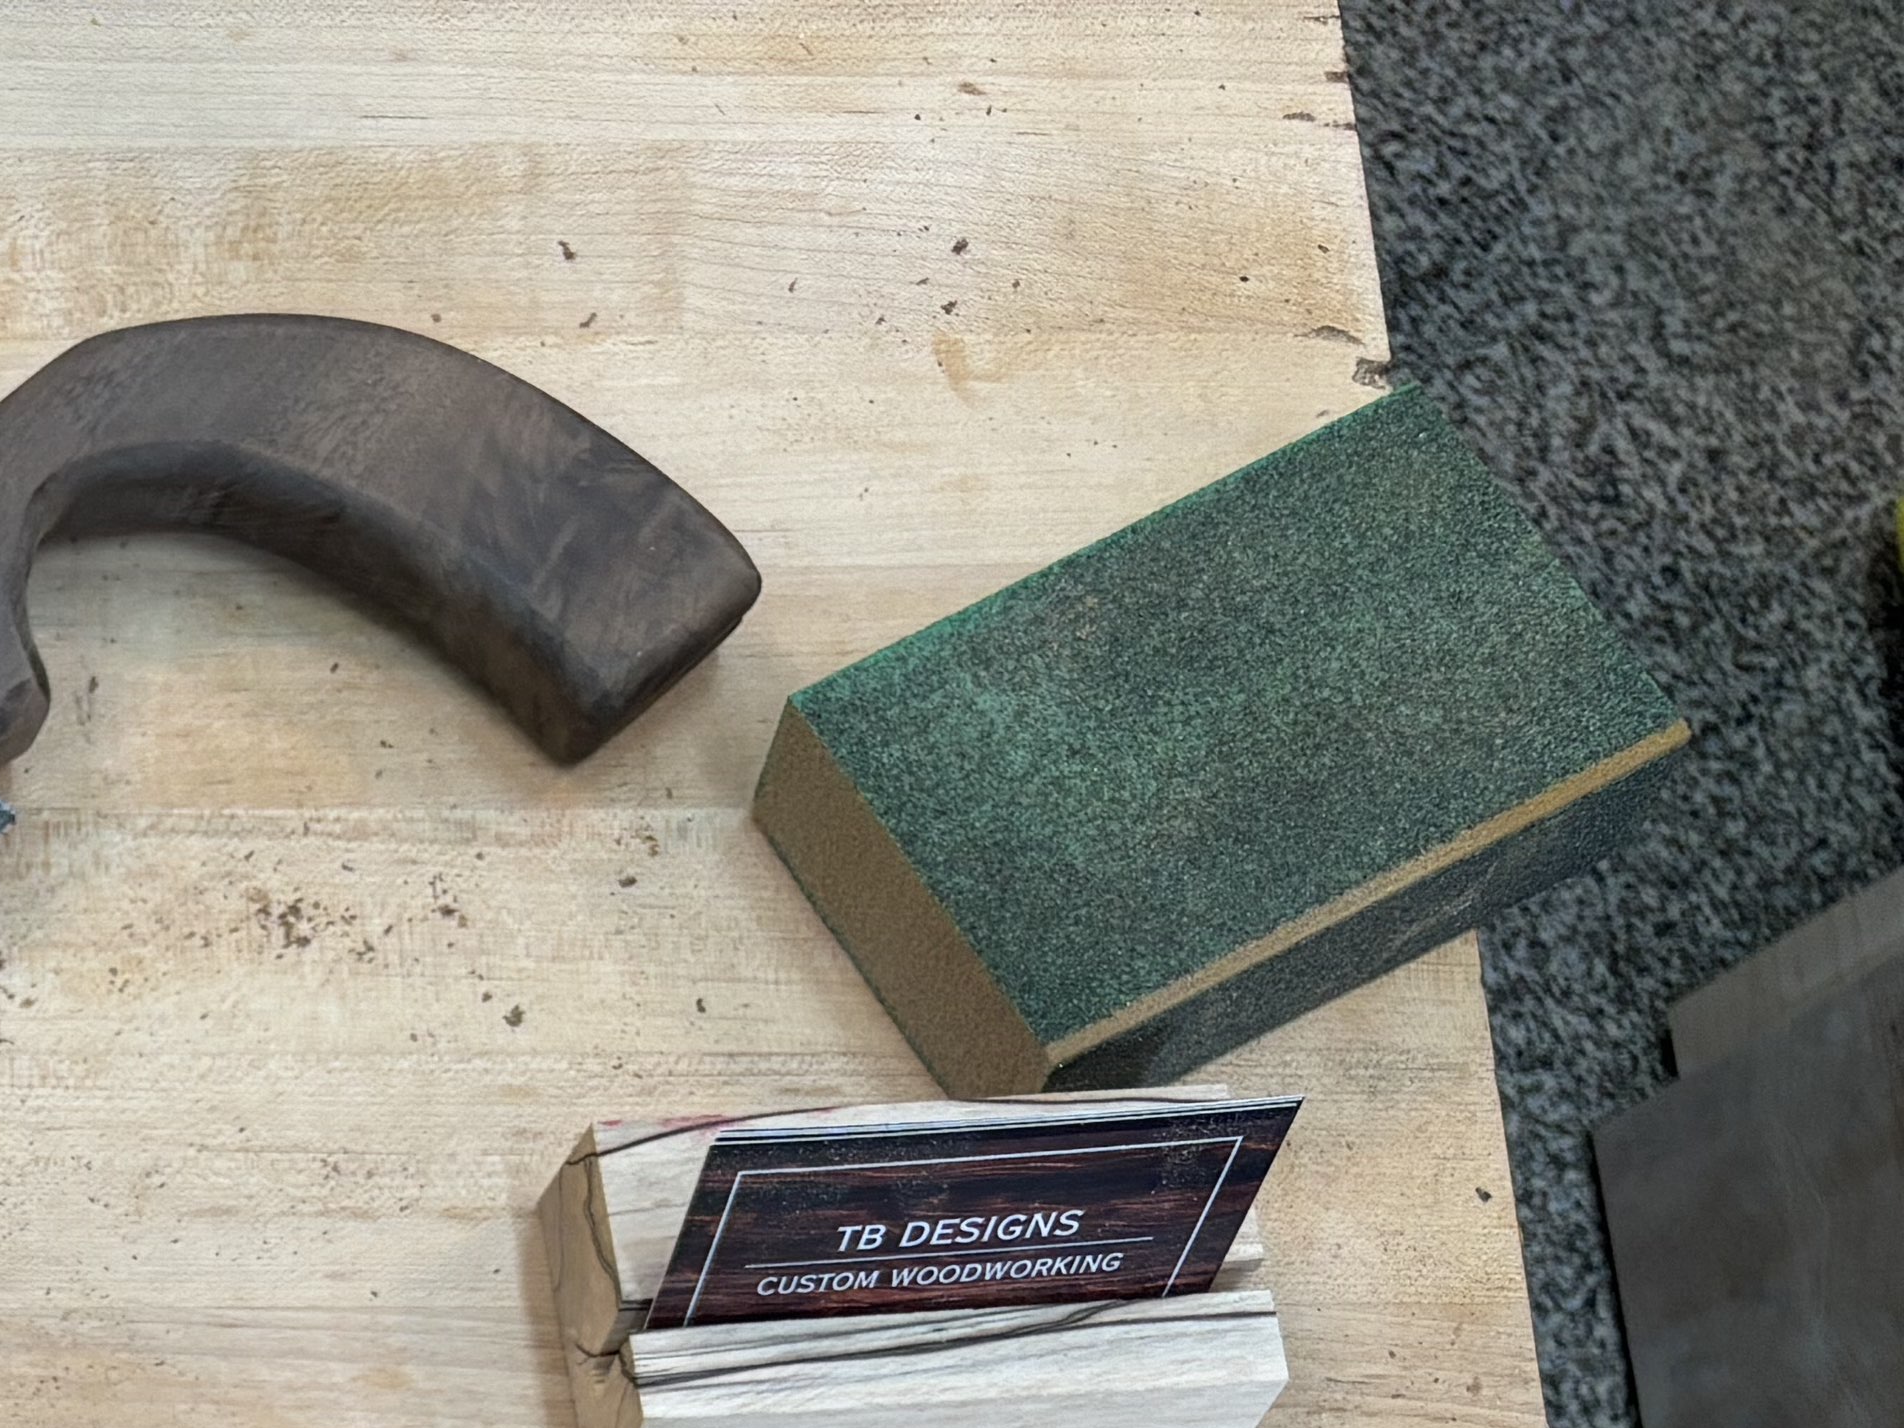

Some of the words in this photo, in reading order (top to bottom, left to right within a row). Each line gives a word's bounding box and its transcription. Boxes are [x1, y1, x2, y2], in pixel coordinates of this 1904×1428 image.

[836, 1224, 887, 1252] TB
[899, 1208, 1086, 1248] DESIGNS
[757, 1269, 880, 1297] CUSTOM
[891, 1252, 1124, 1288] WOODWORKING
